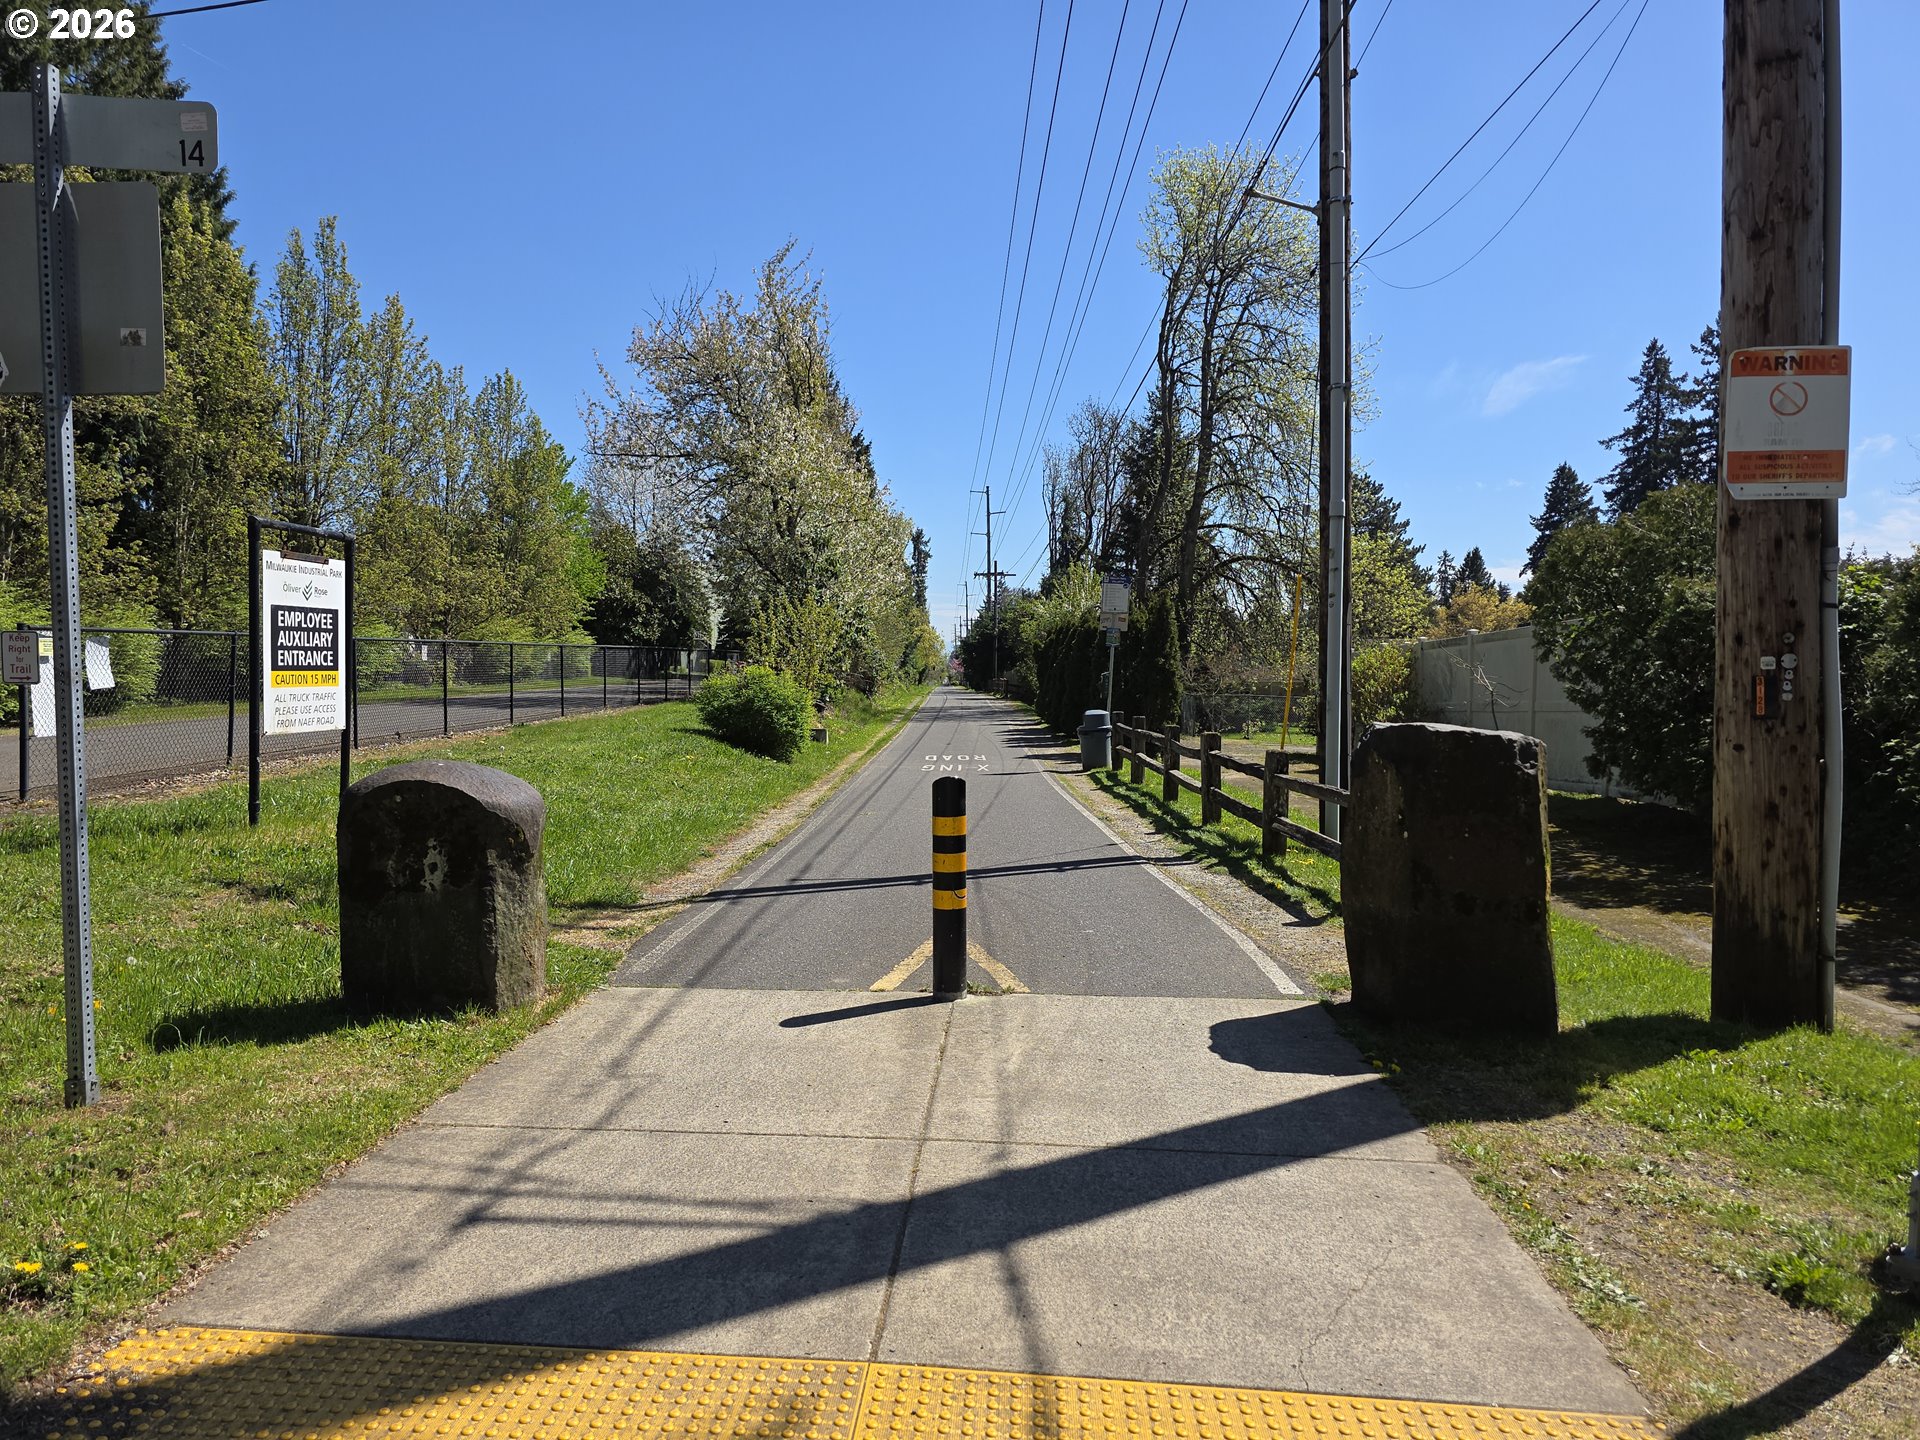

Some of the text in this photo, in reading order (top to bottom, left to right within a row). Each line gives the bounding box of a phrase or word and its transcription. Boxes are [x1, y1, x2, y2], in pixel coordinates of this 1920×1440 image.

[178, 139, 205, 167] 14
[1739, 355, 1841, 371] WARNING
[1754, 462, 1793, 470] SUSPICIOUS
[1760, 472, 1793, 480] SHERIFF'S
[1795, 471, 1840, 479] DEPARTMENT
[265, 560, 343, 579] MILWAUKIE INDUSTRIAL PARK
[314, 586, 328, 596] Rose
[277, 610, 333, 629] EMPLOYEE
[9, 634, 30, 644] Keep
[277, 630, 334, 648] AUXILIARY
[8, 645, 31, 655] Right
[16, 655, 24, 663] for
[277, 649, 334, 666] ENTRANCE
[10, 663, 32, 674] Trail
[275, 673, 337, 685] CAUTION 15 MPH
[274, 692, 337, 703] ALL TRUCK TRAFFIC
[275, 704, 337, 716] PLEASE USE ACCESS
[276, 716, 335, 728] FROM NAEF ROAD
